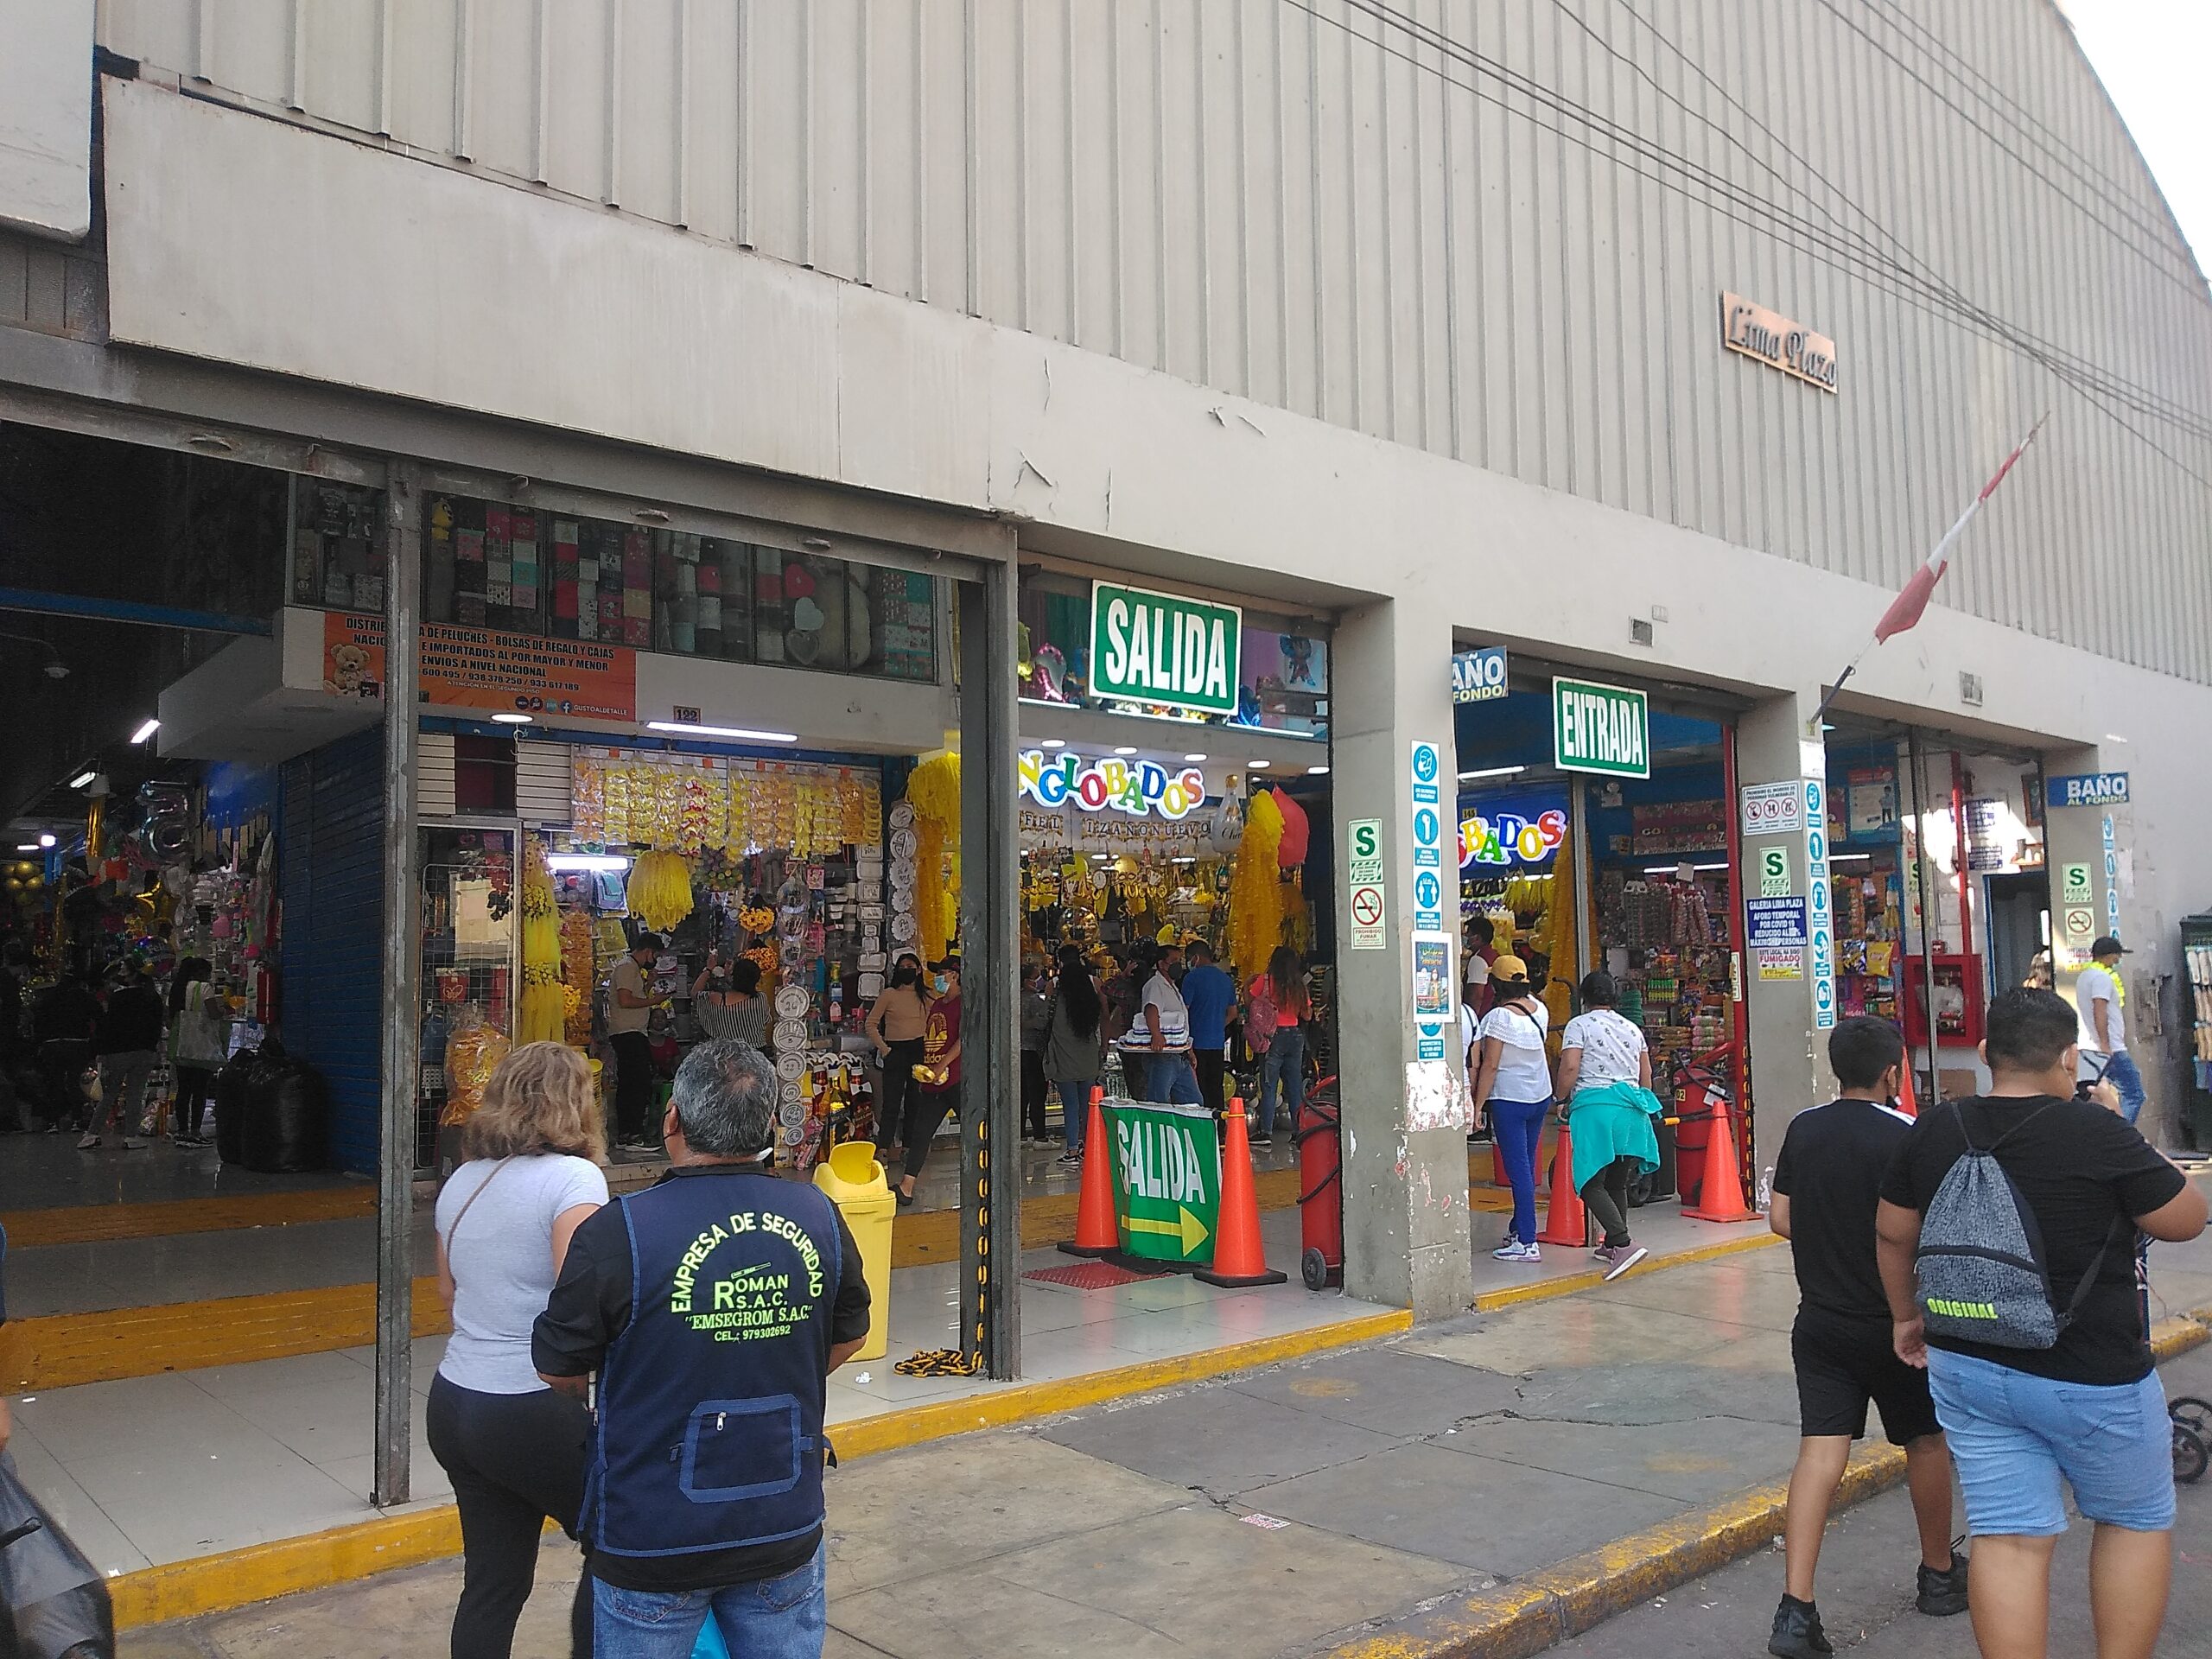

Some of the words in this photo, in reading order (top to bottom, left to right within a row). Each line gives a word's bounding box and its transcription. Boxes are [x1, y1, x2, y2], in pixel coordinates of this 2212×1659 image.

[1729, 307, 1781, 361] Lima
[1786, 331, 1837, 386] Plaza
[428, 627, 439, 638] DE
[442, 629, 487, 644] PELUCHES
[496, 635, 530, 649] BOLSAS
[533, 640, 543, 651] DE
[546, 642, 578, 655] REGALO
[580, 646, 587, 655] Y
[588, 647, 614, 659] CAJAS
[1105, 598, 1228, 698] SALIDA
[422, 655, 458, 668] ENVIOS
[461, 659, 467, 669] A
[470, 660, 497, 672] NIVEL
[499, 664, 547, 677] NACIONAL
[429, 643, 495, 659] IMPORTADOS
[498, 650, 508, 659] AL
[512, 652, 531, 663] POR
[533, 655, 566, 666] MAYOR
[569, 658, 574, 667] Y
[576, 659, 608, 671] MENOR
[1452, 652, 1504, 690] AÑO
[1452, 685, 1503, 703] FONDO
[574, 705, 628, 716] GUSTOALDETALLE
[677, 709, 697, 721] 122
[1561, 690, 1644, 766] ENTRADA
[1019, 753, 1204, 816] NGLOBADOS
[2067, 774, 2126, 798] BAÑO
[2085, 795, 2126, 804] FONDO
[1356, 826, 1376, 857] S
[1459, 810, 1565, 863] BADOS
[1765, 852, 1784, 876] S
[2069, 868, 2086, 886] S
[1749, 900, 1771, 911] GALERIA
[1772, 899, 1785, 909] LIMA
[1786, 899, 1803, 909] PLAZA
[1753, 912, 1771, 921] AFORO
[1771, 911, 1801, 920] TEMPORAL
[1754, 929, 1782, 938] REDUCIDO
[1771, 920, 1788, 929] COVID
[1117, 1120, 1206, 1204] SALIDA
[671, 1224, 729, 1313] EMPRESA
[729, 1212, 757, 1234] DE
[761, 1211, 823, 1298] SEGURIDAD
[714, 1274, 789, 1310] ROMAN
[735, 1291, 788, 1309] S.A.C.
[1927, 1298, 1999, 1319] ORIGINAL
[742, 1325, 791, 1340] 979302692
